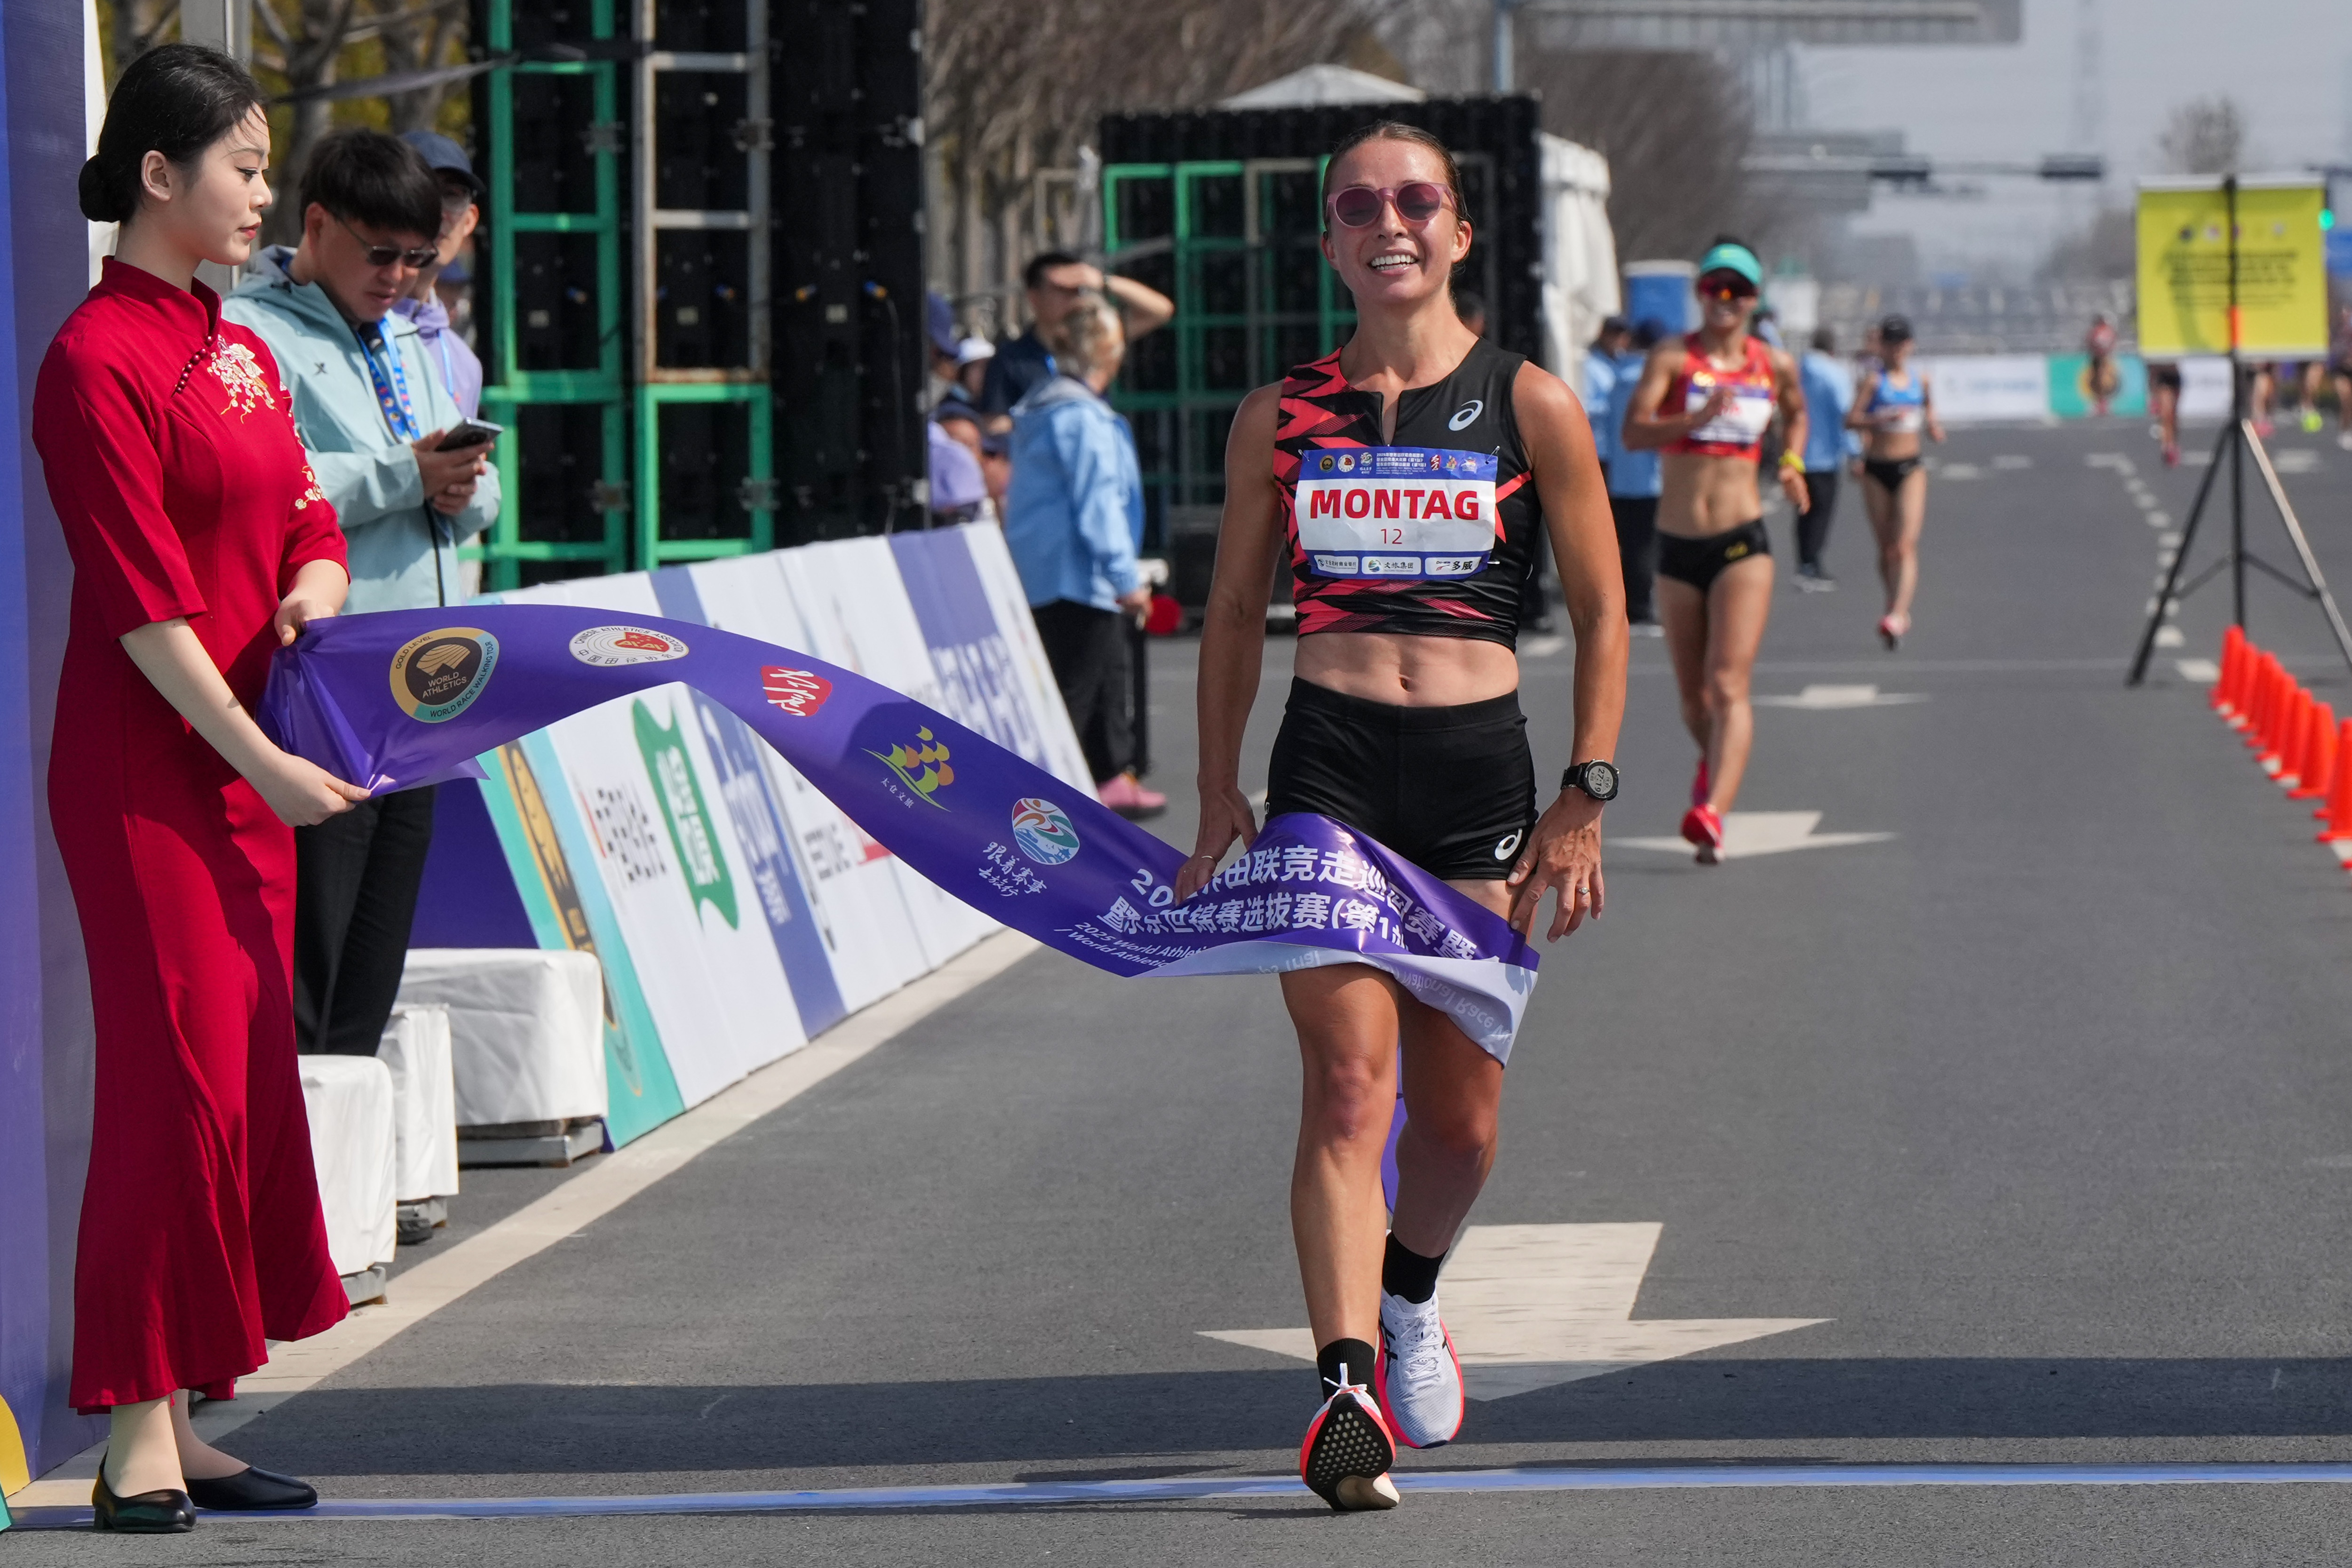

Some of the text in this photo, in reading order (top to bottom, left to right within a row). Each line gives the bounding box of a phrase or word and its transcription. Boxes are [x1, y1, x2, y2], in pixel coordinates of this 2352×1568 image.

[1310, 489, 1479, 520] MONTAG
[1381, 528, 1402, 544] 12
[1452, 561, 1473, 571] 多威
[396, 636, 433, 669] GOLD LEVEL
[577, 649, 674, 664] 中国田径协会
[422, 677, 467, 699] ATHLETICS
[428, 672, 459, 687] WORLD
[430, 641, 493, 717] WORLD RACE WALKING TOUR
[1595, 768, 1605, 792] 27:19
[880, 777, 914, 809] 太仓文旅
[1068, 931, 1117, 953] World
[1074, 922, 1116, 941] 2025
[1113, 940, 1161, 954] World
